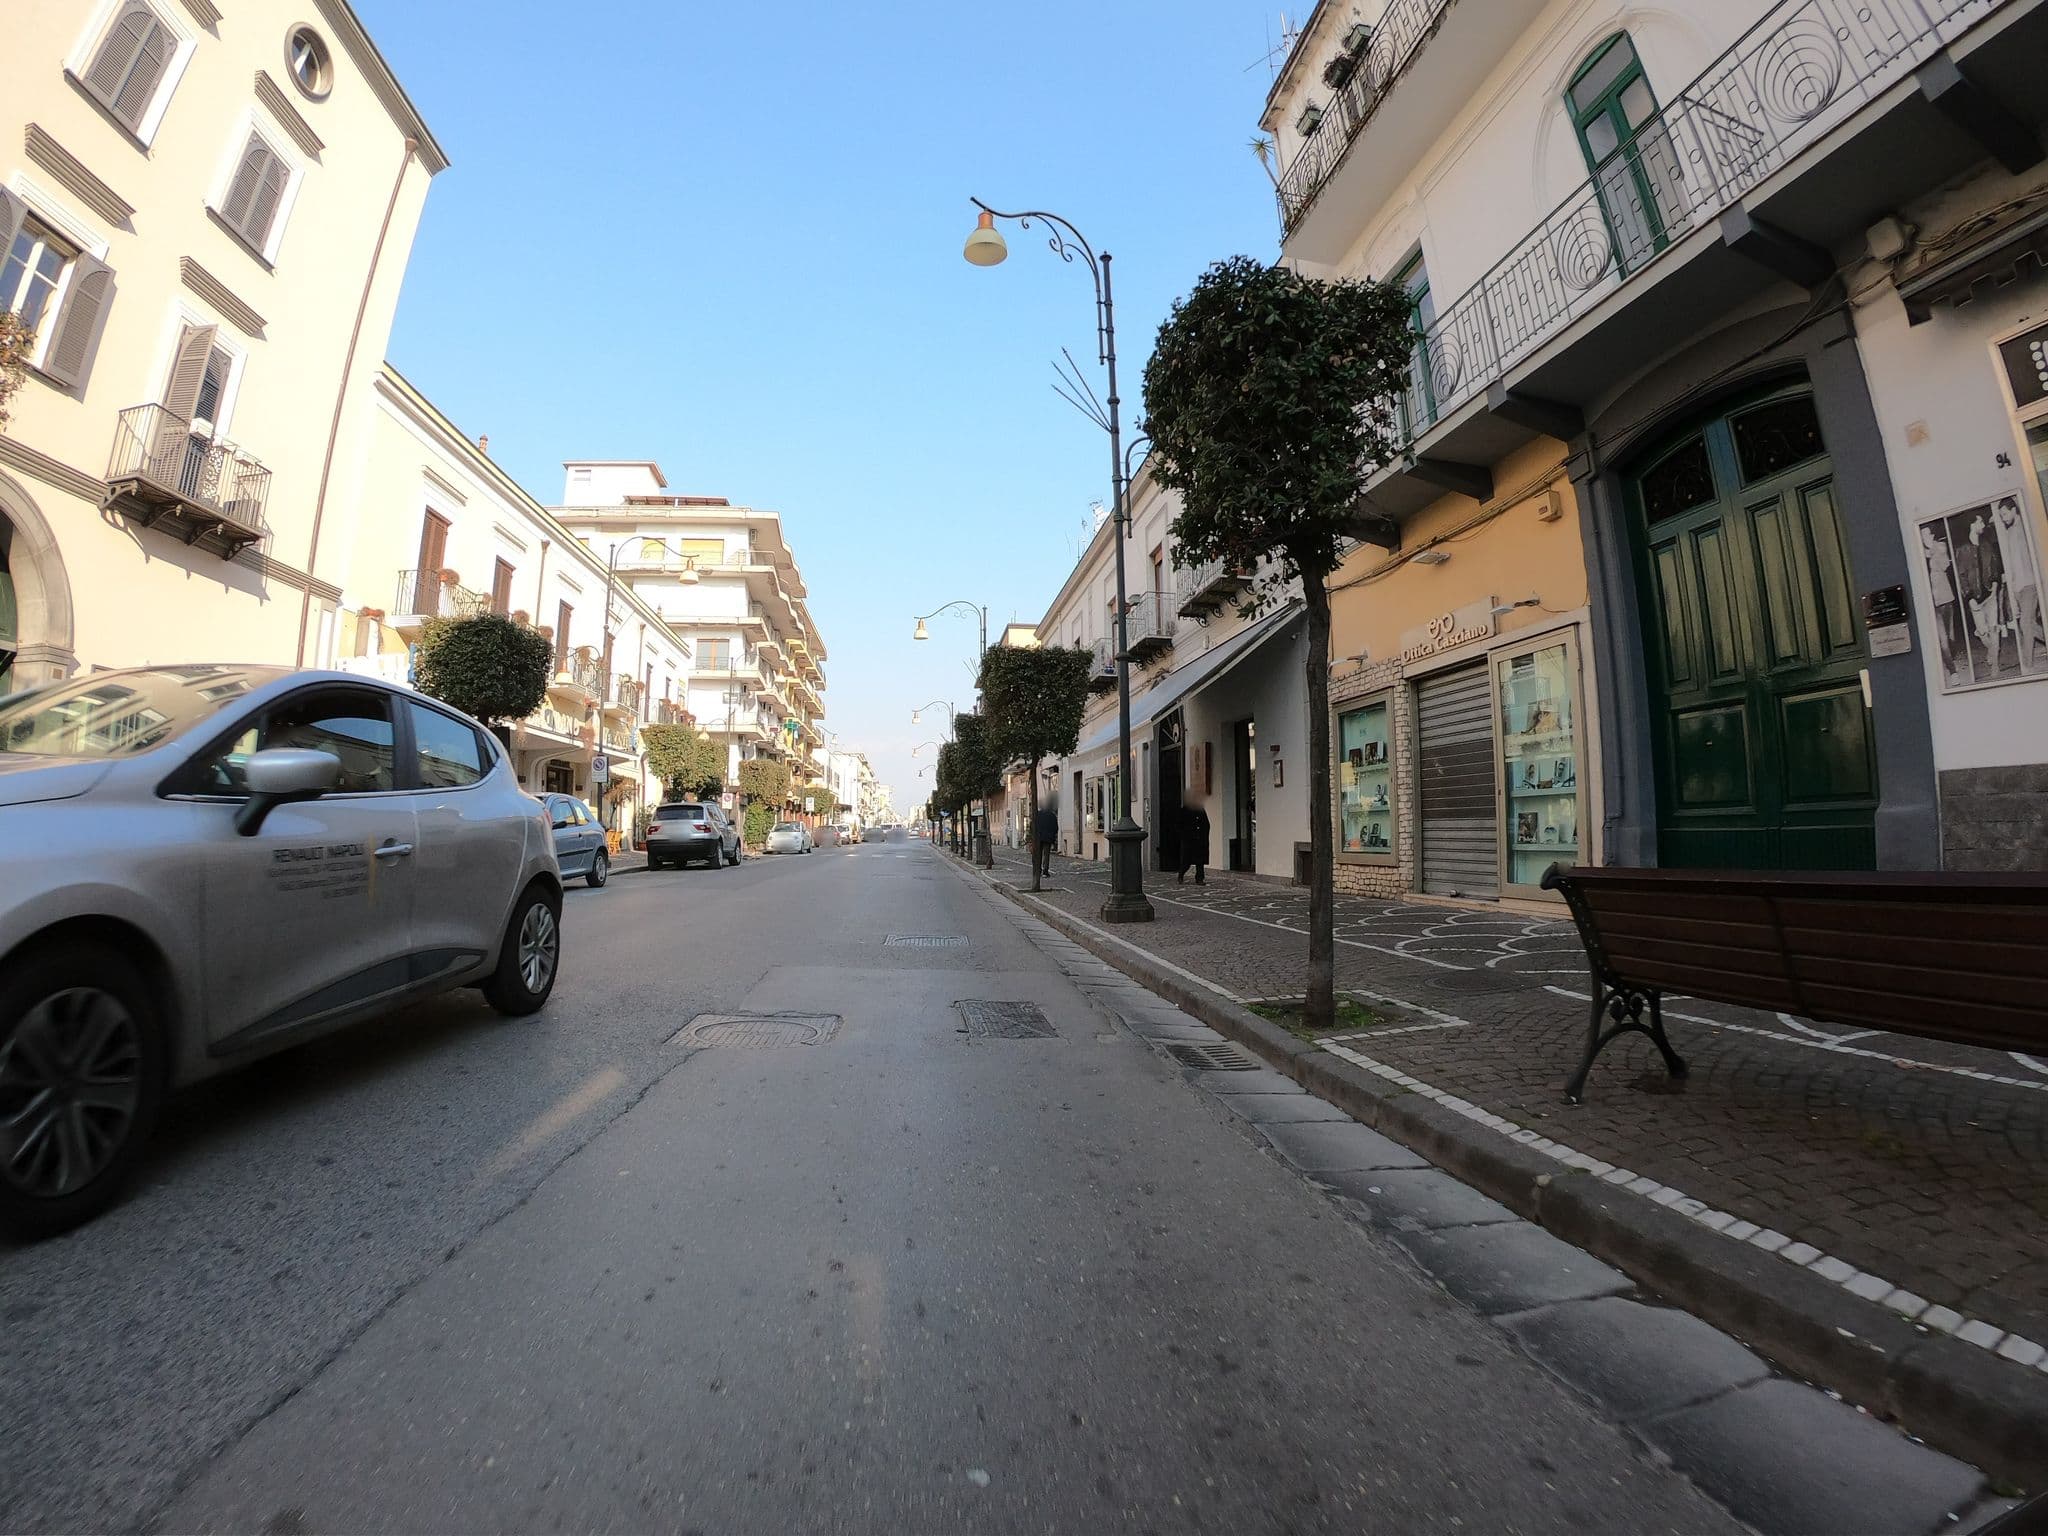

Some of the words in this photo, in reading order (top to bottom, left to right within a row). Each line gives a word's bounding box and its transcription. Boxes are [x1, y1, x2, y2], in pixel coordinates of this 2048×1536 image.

[1996, 451, 2012, 469] 94
[1402, 643, 1435, 662] Ottica
[1436, 624, 1488, 650] Casciano
